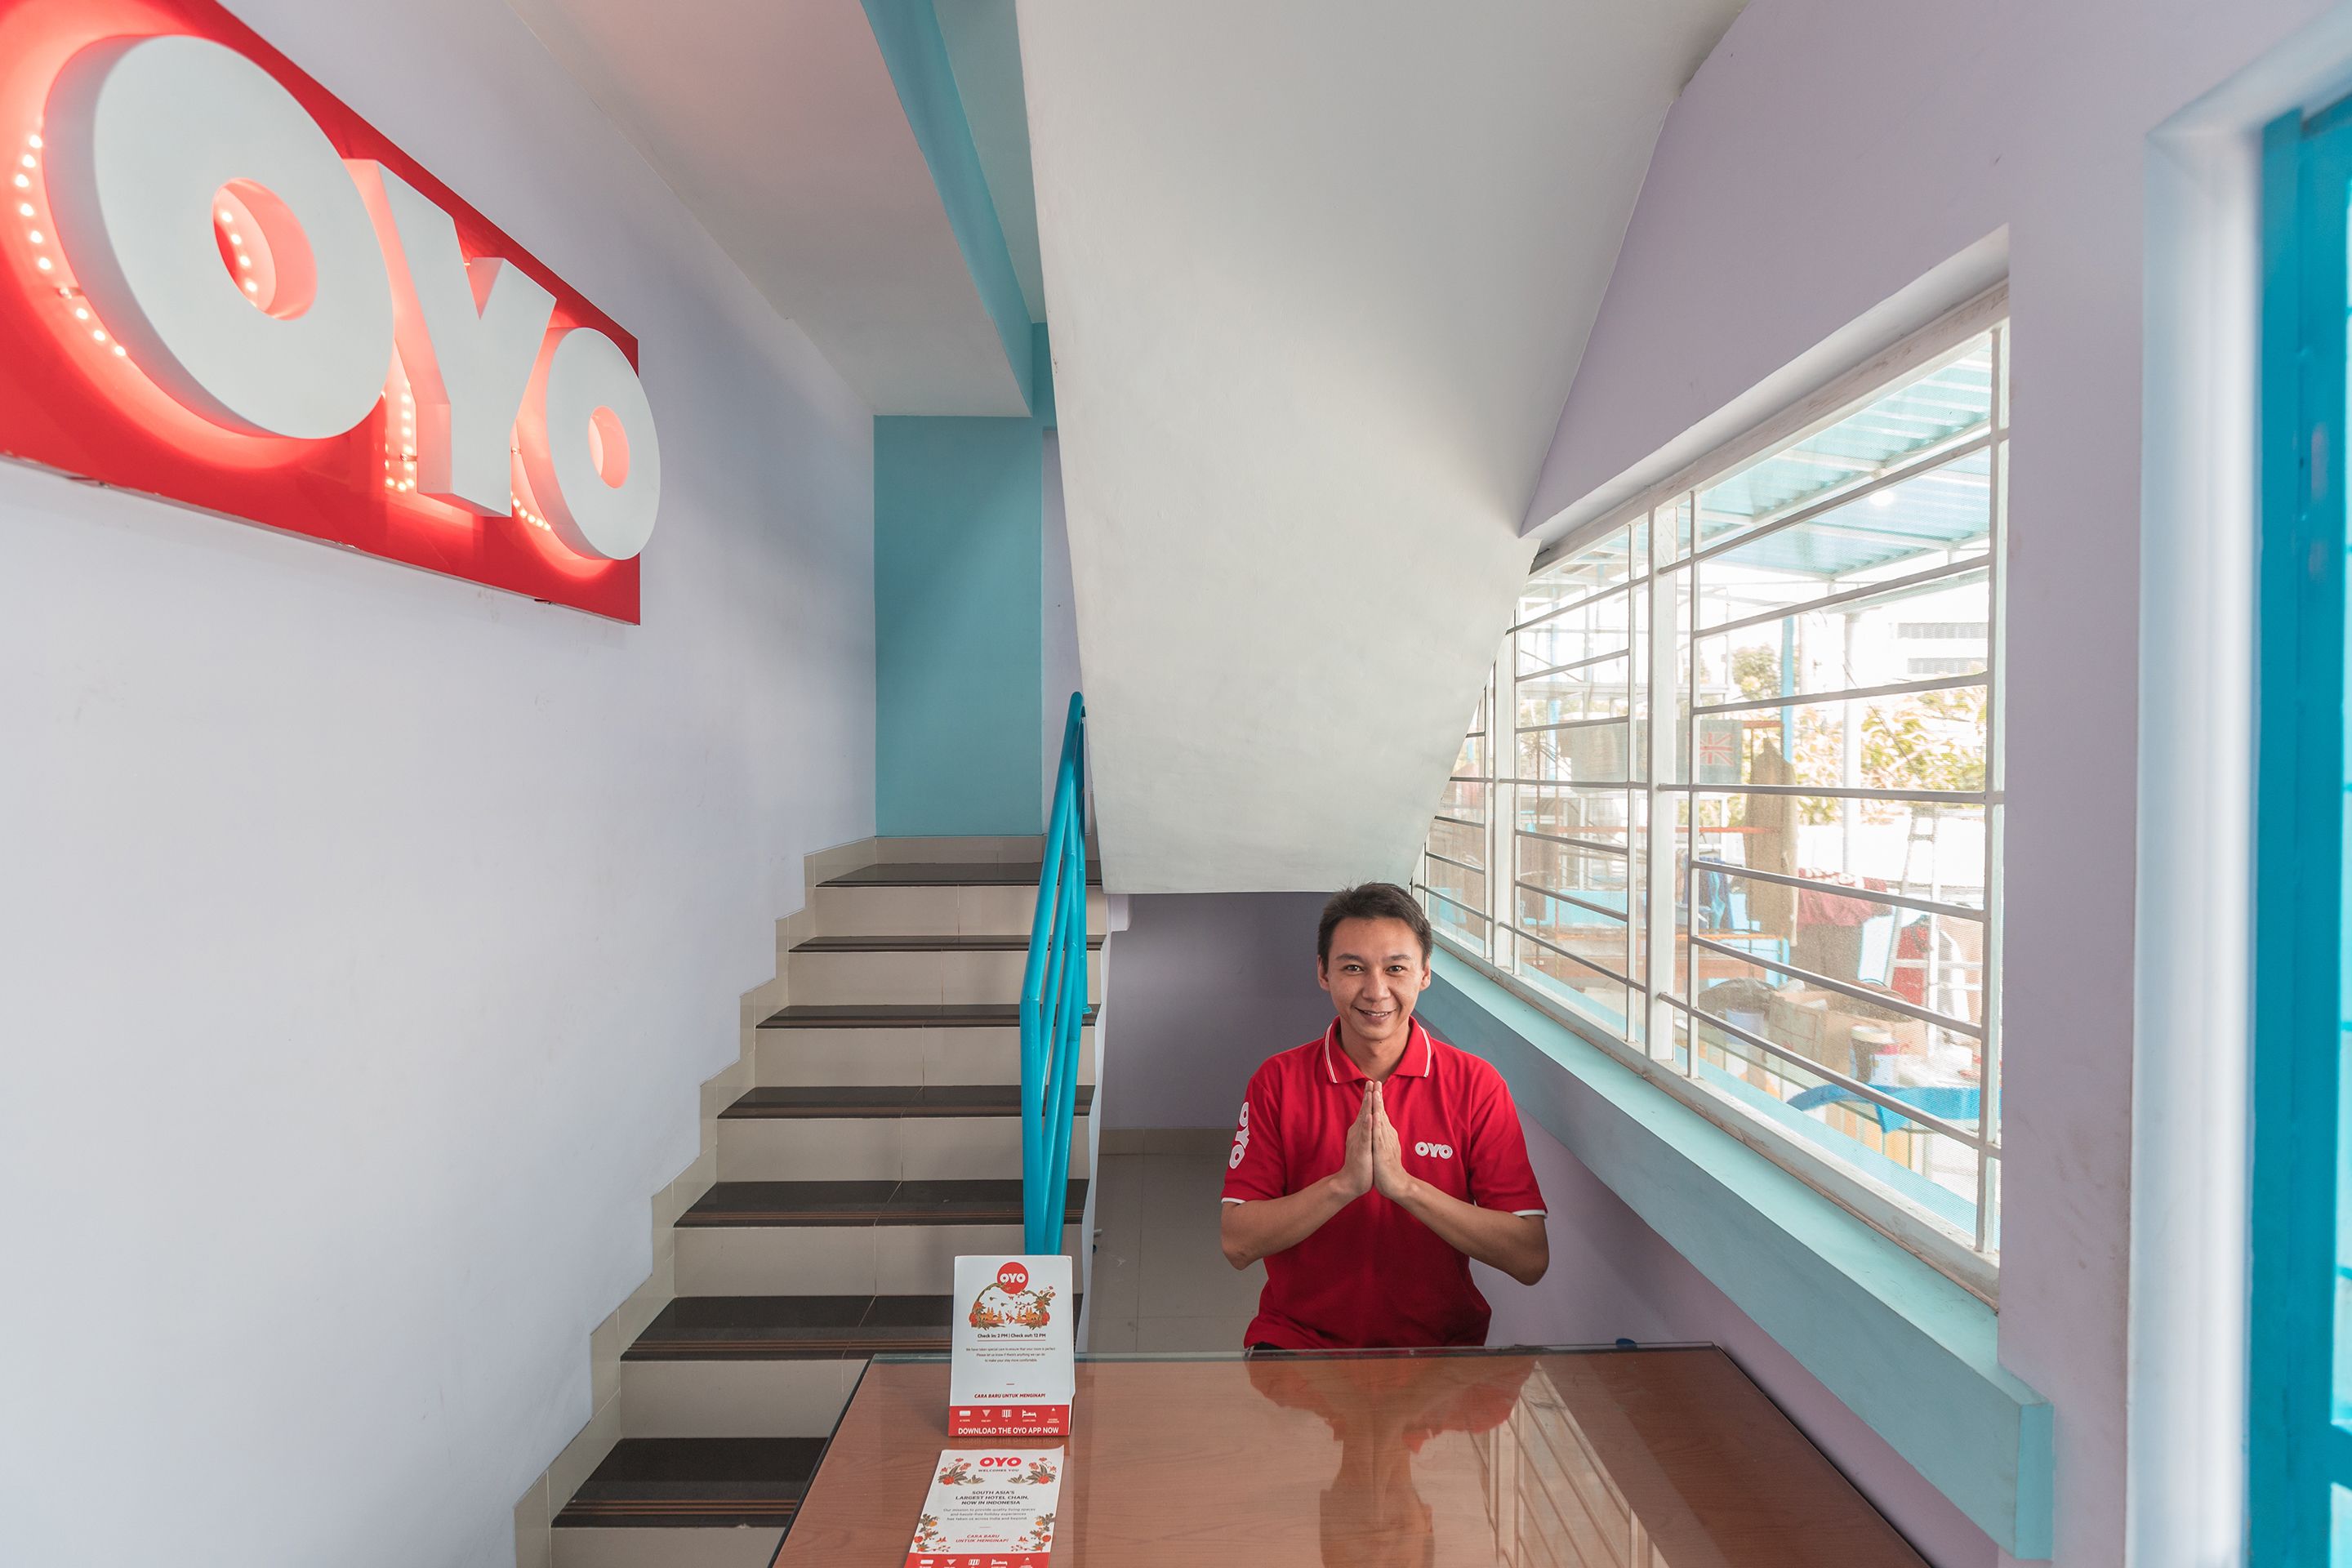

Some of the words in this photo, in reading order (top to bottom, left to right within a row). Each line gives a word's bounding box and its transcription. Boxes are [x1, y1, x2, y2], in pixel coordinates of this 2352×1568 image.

[42, 34, 661, 560] OYO
[1229, 1102, 1250, 1169] OYO
[1414, 1142, 1453, 1160] OYO
[1000, 1273, 1026, 1283] OYO
[980, 1457, 1022, 1467] OYO
